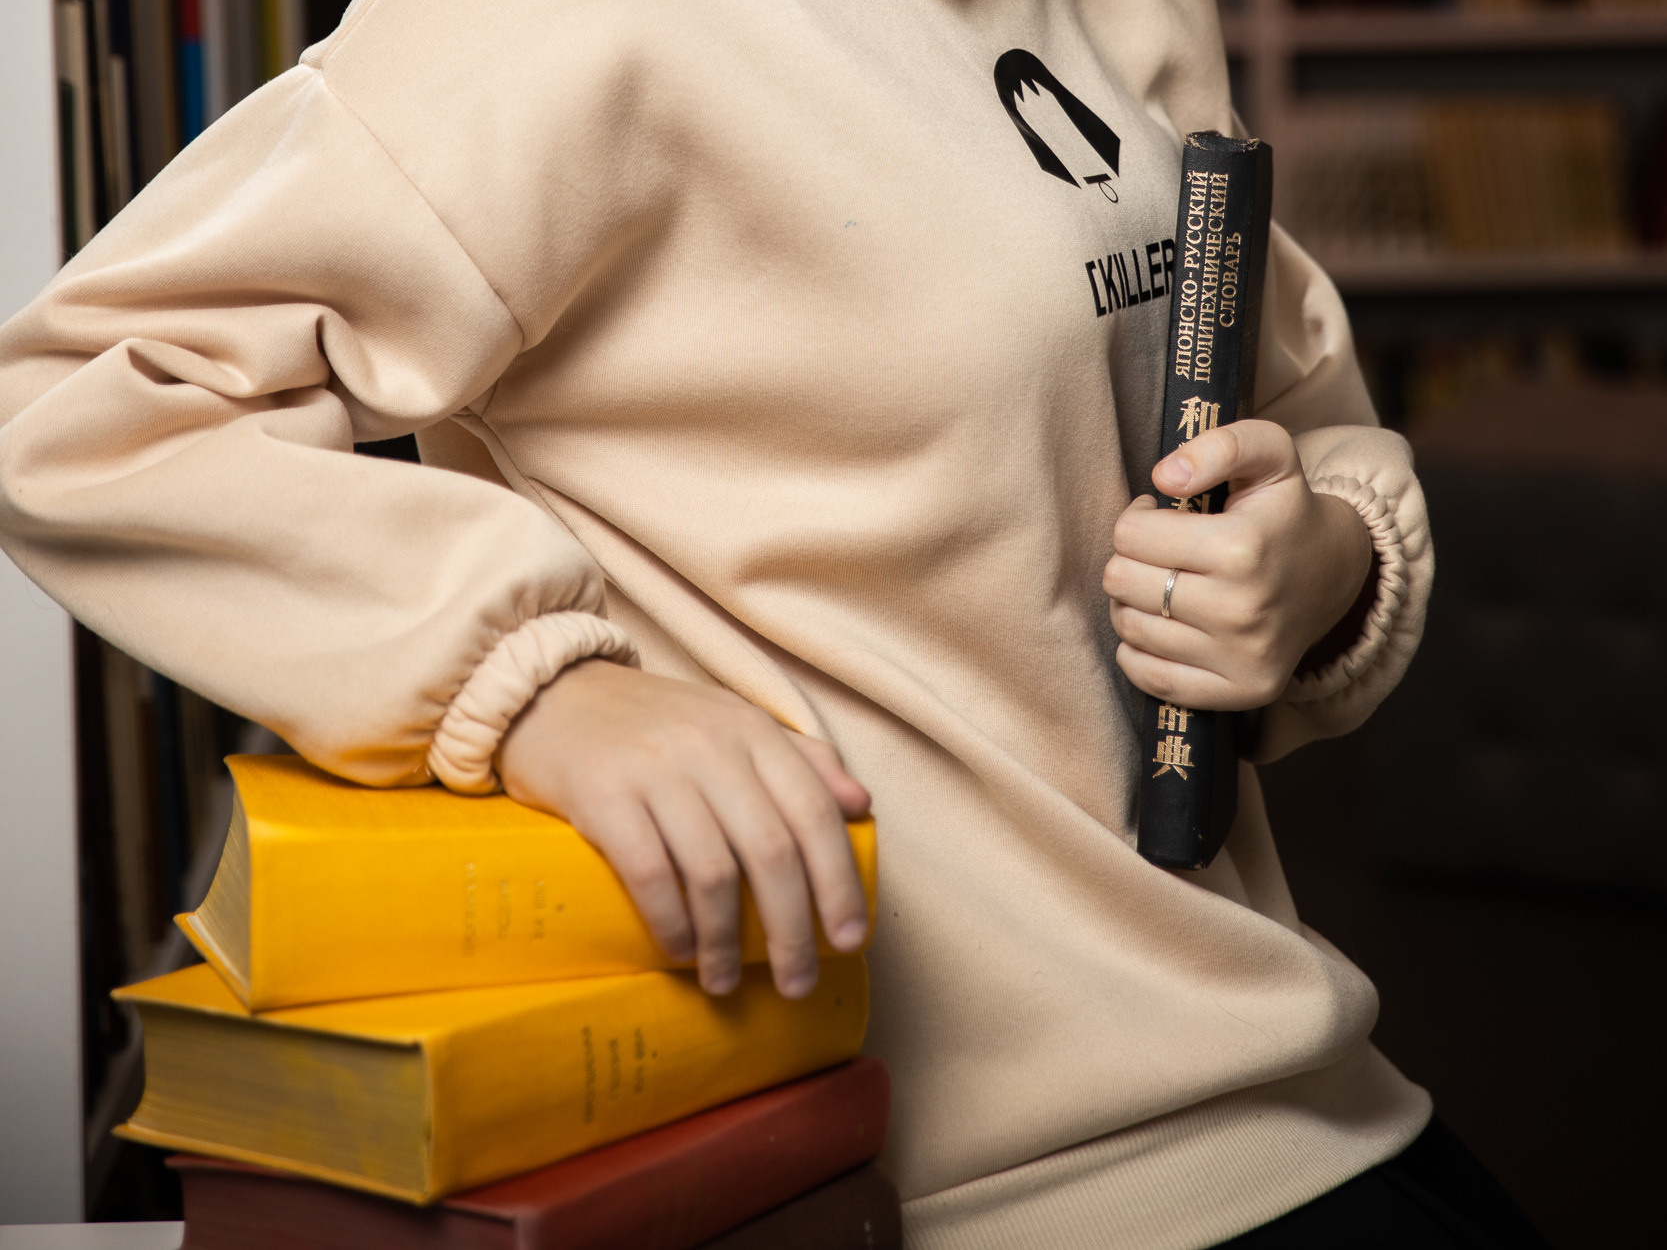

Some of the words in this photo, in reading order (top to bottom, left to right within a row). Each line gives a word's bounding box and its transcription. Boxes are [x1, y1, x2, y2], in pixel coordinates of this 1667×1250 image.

[1176, 169, 1209, 380] ЯПОНСКО-РУССКИЙ
[1194, 172, 1229, 384] ПОЛИТЕХНИЧЕСКИЙ
[1219, 231, 1242, 328] СЛОВАРЬ
